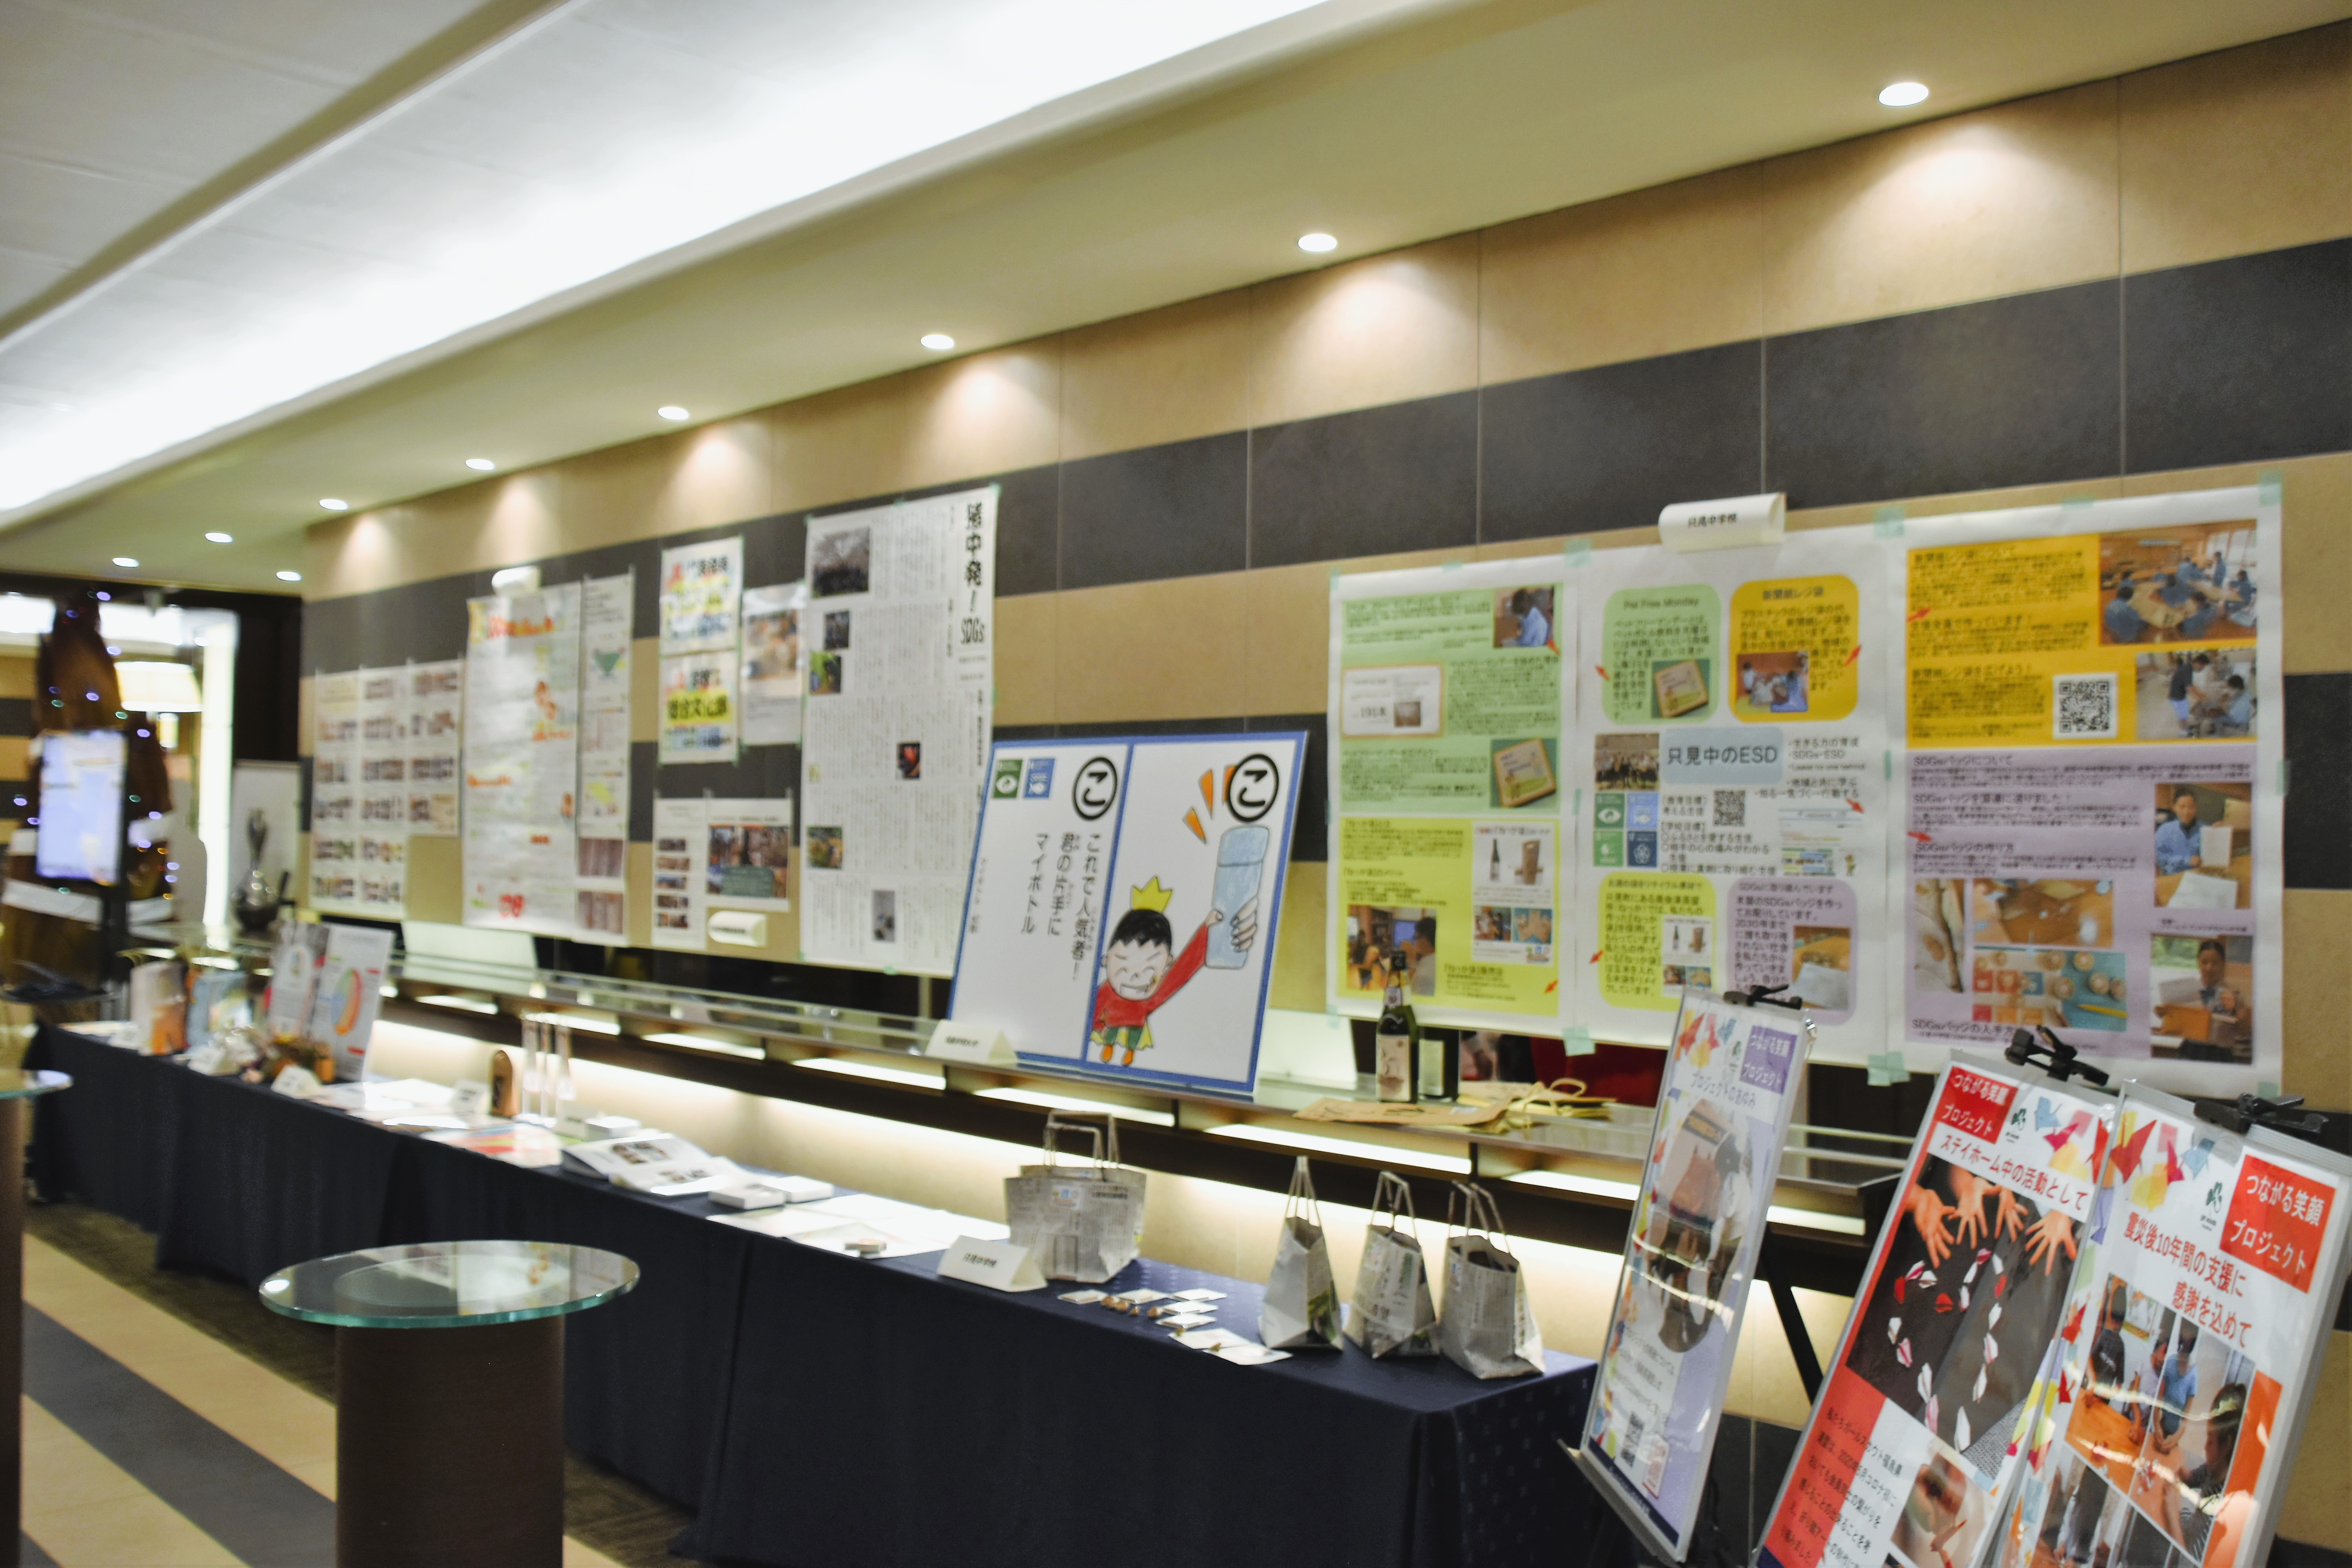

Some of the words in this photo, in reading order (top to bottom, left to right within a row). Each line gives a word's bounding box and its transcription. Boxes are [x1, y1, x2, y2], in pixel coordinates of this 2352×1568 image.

[1668, 746, 1778, 766] 只見中のESD
[1083, 771, 1108, 807] こ
[1238, 769, 1268, 807] こ
[1953, 1073, 2010, 1105] つながる笑顔
[1941, 1103, 1994, 1137] プロジェクト
[1940, 1134, 2089, 1211] ステイホーム中の活動として
[2246, 1174, 2326, 1228] つながる笑顔
[2123, 1211, 2248, 1298] 震災後10年間の支援に
[2230, 1218, 2306, 1275] プロジェクト
[2172, 1281, 2253, 1348] 感謝を込めて
